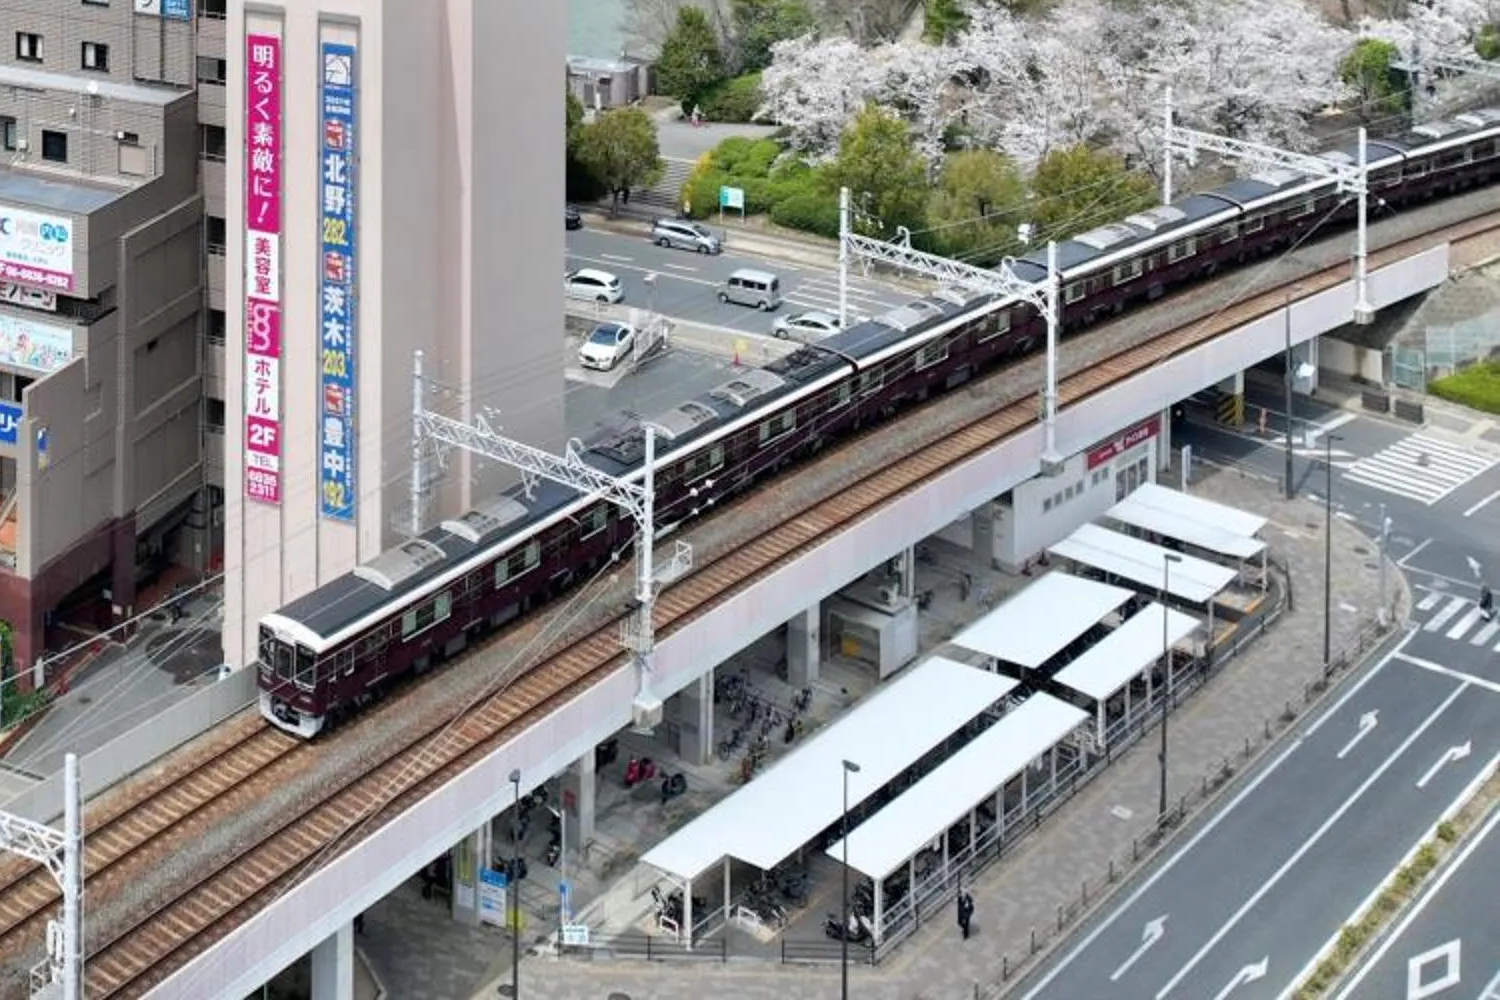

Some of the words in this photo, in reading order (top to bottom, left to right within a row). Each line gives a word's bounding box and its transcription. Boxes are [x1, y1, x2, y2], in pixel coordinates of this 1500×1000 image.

[324, 153, 346, 214] 北野
[254, 237, 272, 295] 美容室
[324, 286, 345, 348] 茨木
[255, 359, 271, 414] ホテル
[249, 424, 277, 447] 2F
[324, 417, 345, 478] 豊中
